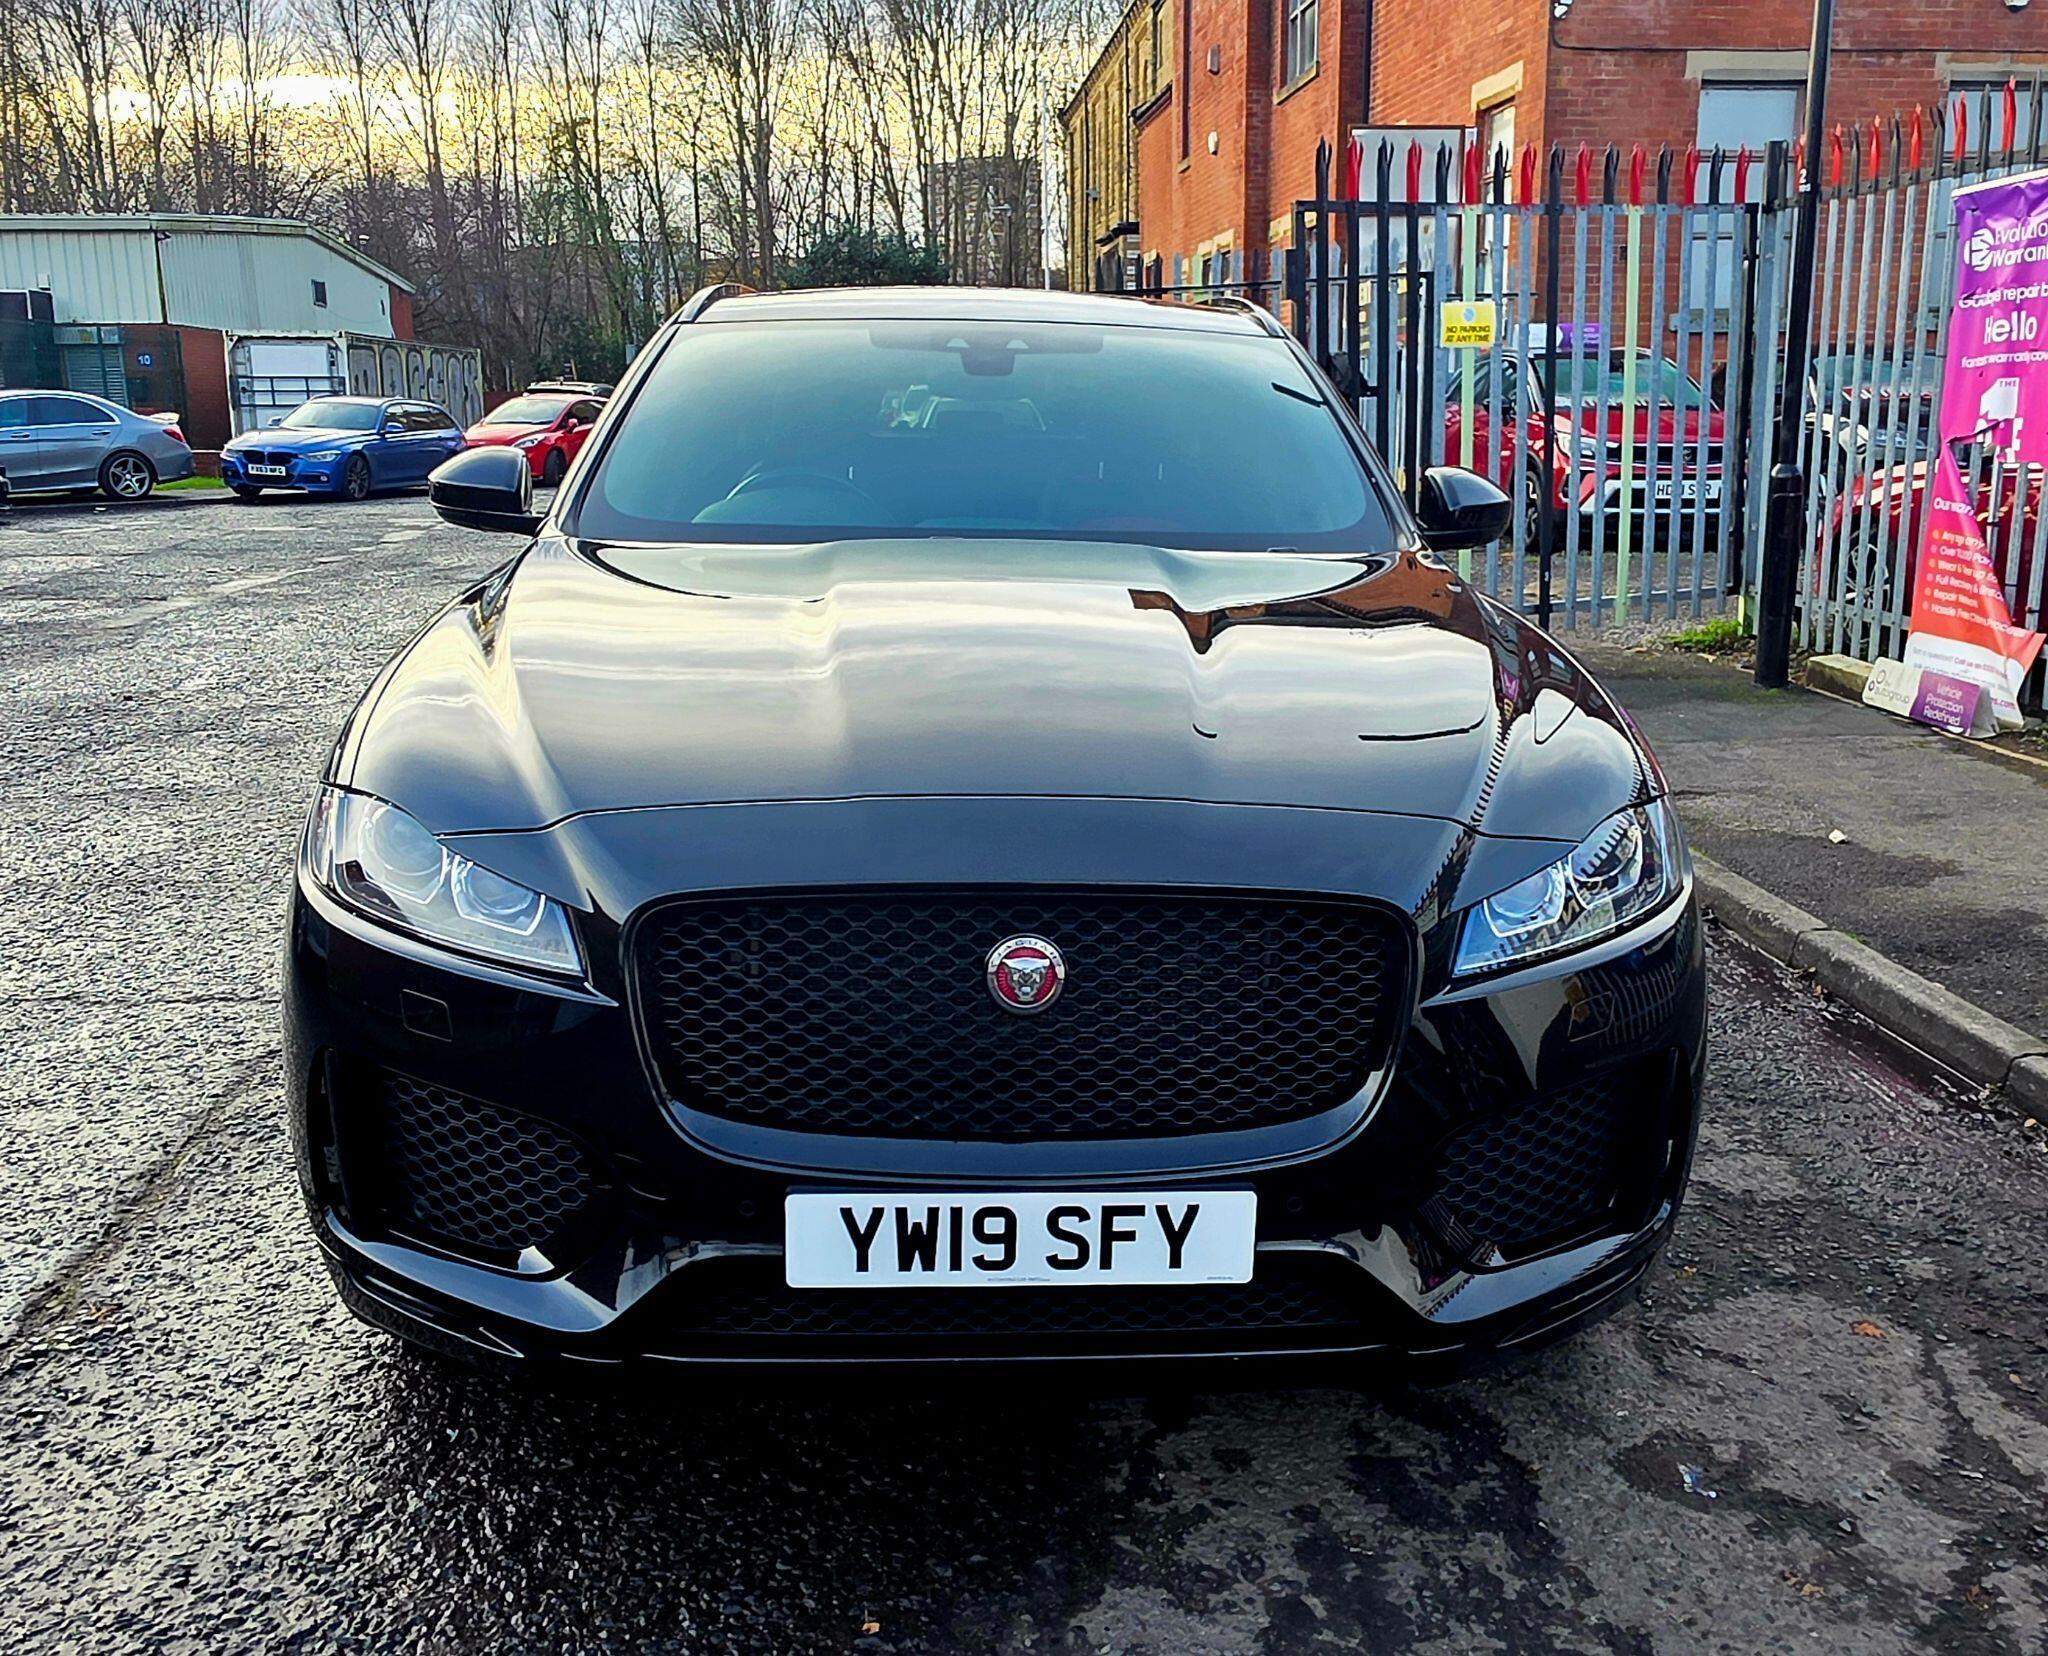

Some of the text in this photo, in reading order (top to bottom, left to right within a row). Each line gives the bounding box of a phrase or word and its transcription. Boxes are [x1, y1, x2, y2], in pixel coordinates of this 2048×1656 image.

[1460, 325, 1490, 333] PARKING
[1984, 310, 2038, 345] Hello
[1474, 334, 1489, 342] TIME
[138, 354, 150, 365] 10
[1688, 484, 1712, 496] SR
[839, 1203, 1201, 1273] YW19 SFY
